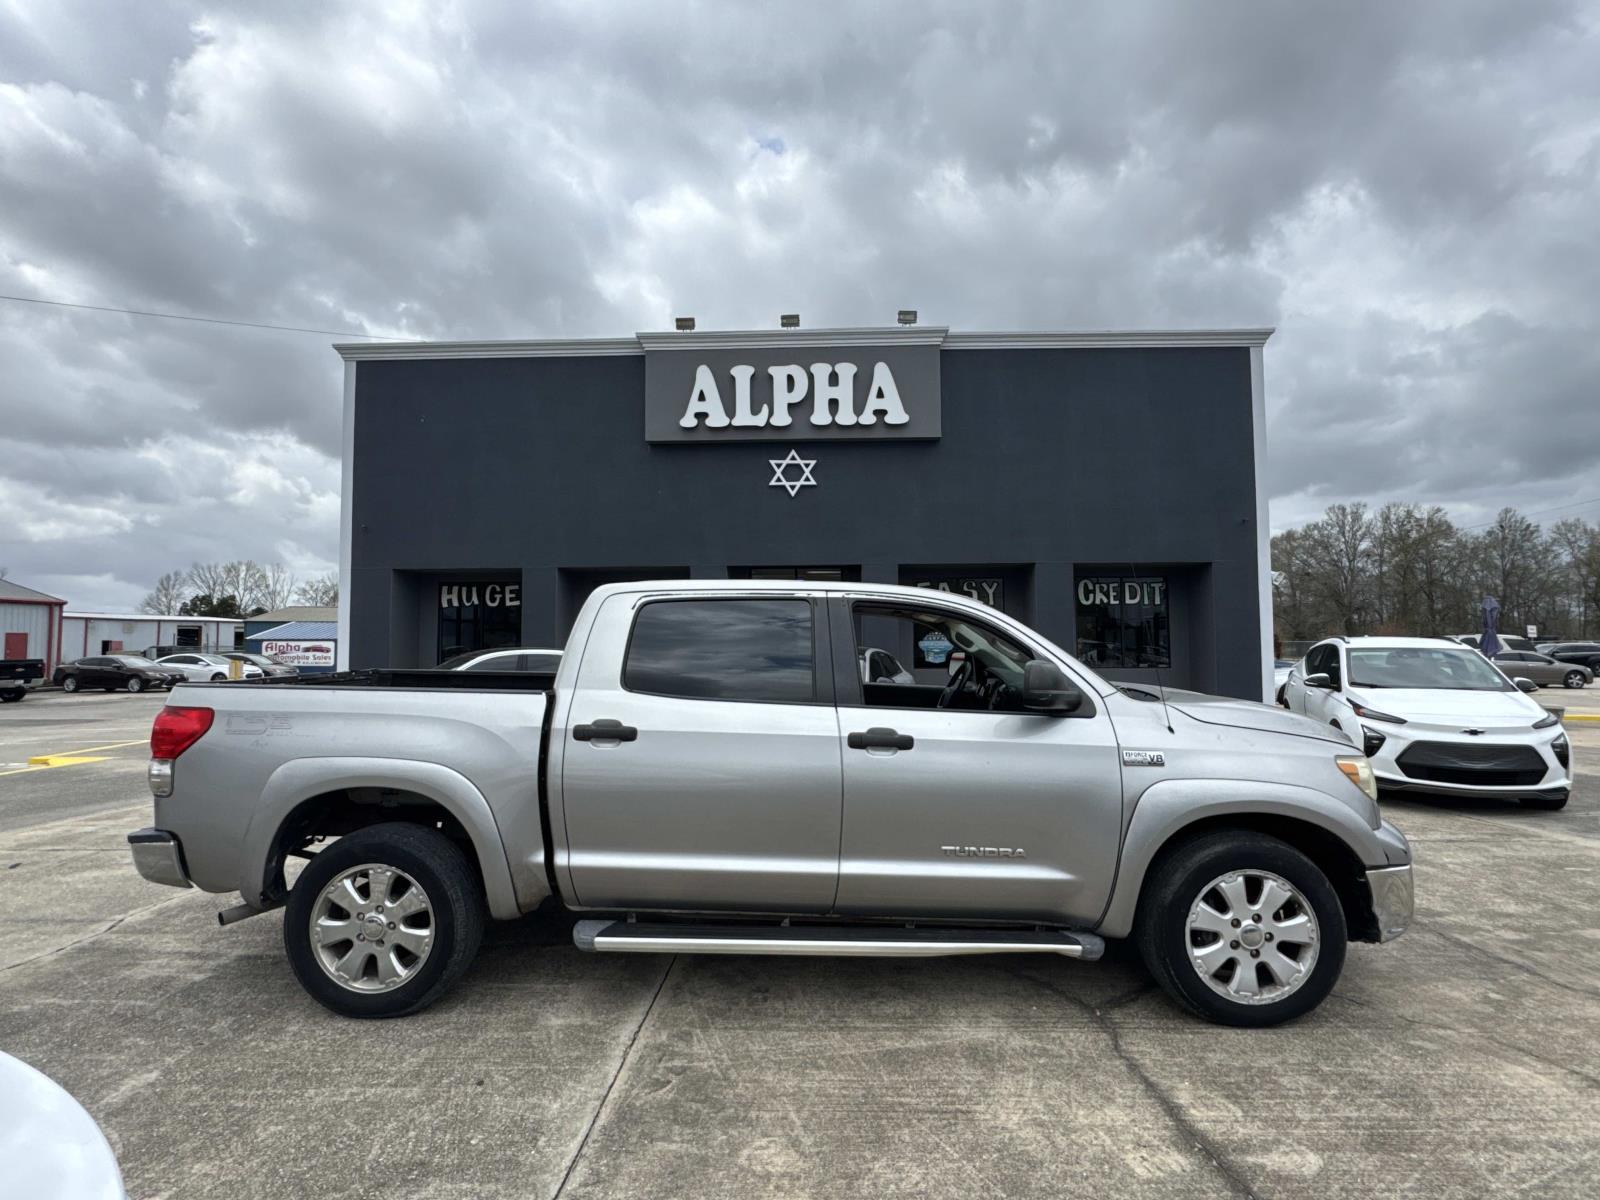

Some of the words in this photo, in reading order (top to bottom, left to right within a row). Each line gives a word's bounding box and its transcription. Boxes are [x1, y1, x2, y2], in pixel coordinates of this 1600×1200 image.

[679, 361, 910, 428] ALPHA
[441, 584, 521, 608] HUGE
[917, 581, 998, 605] ASY
[1078, 579, 1164, 605] CREDIT
[265, 642, 301, 653] Alpha
[941, 846, 1026, 859] TUNDRA
